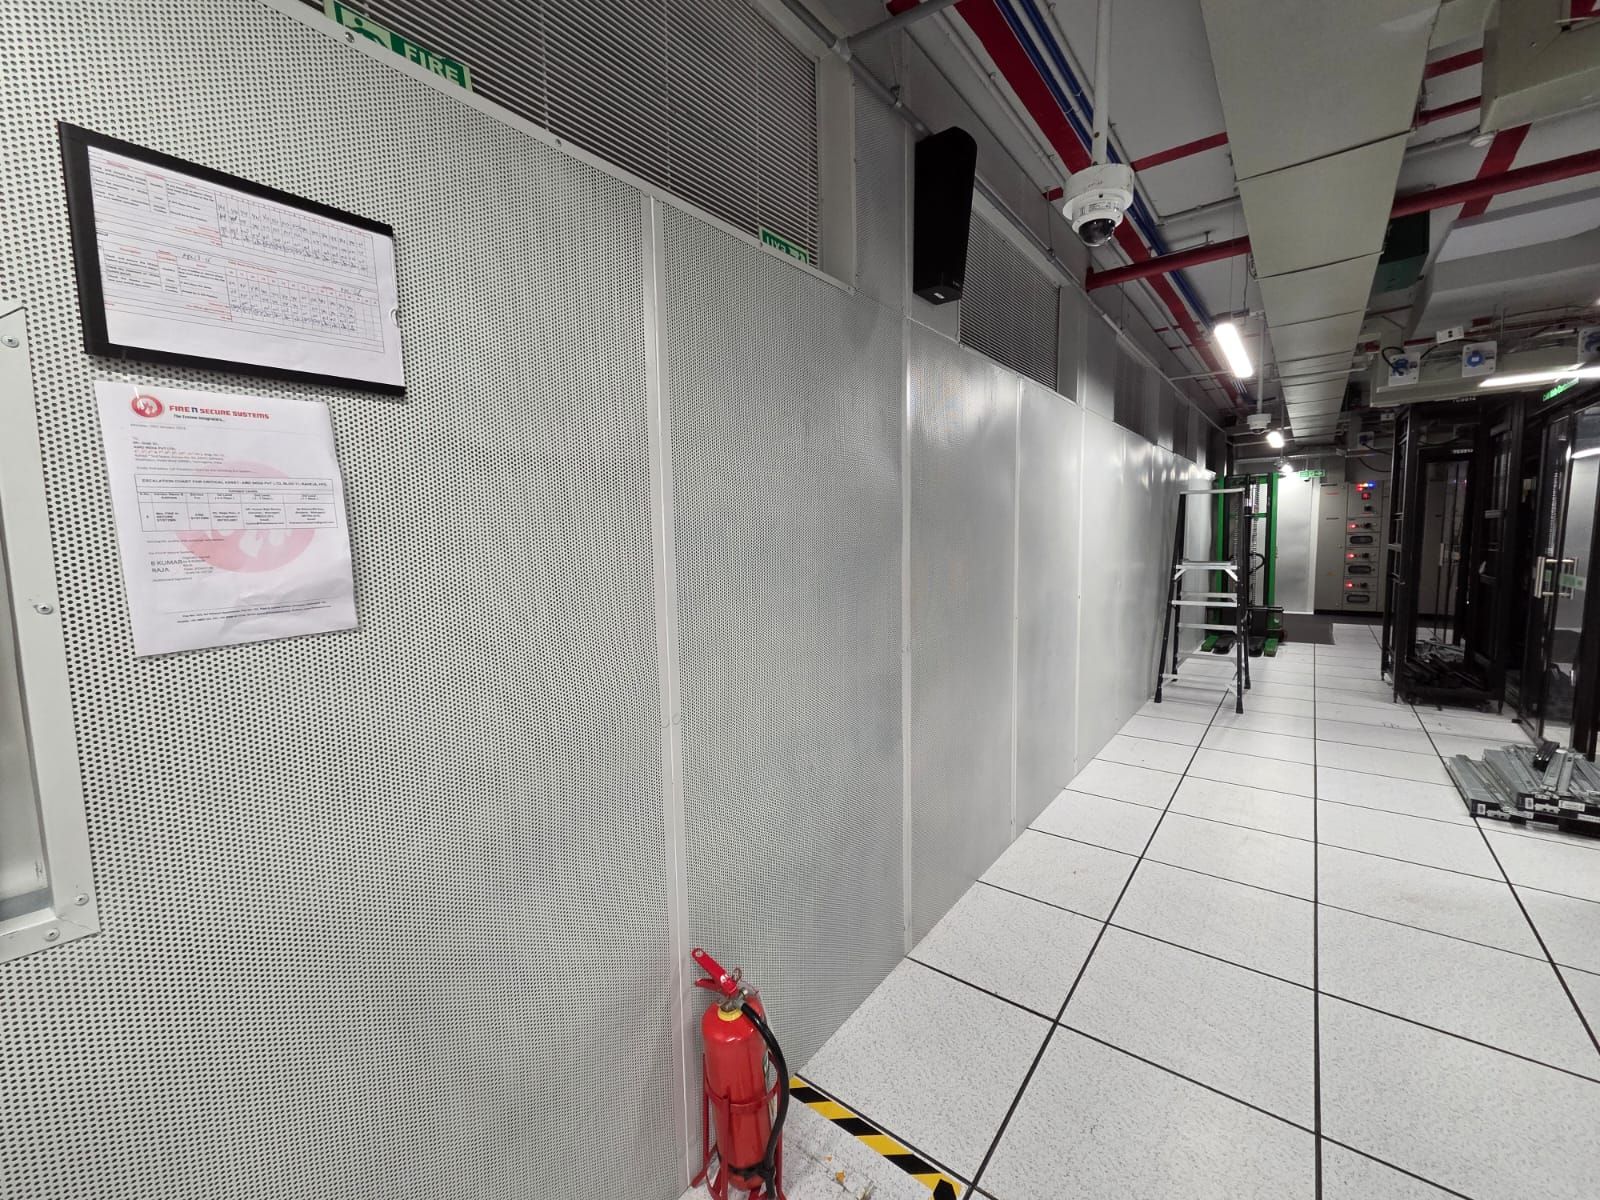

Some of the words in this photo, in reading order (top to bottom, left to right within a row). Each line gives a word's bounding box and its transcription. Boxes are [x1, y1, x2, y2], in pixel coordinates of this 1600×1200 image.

[403, 42, 459, 82] FIRE
[169, 404, 190, 413] FIRE
[200, 408, 231, 416] SECURE
[232, 411, 269, 420] SYSTEMS
